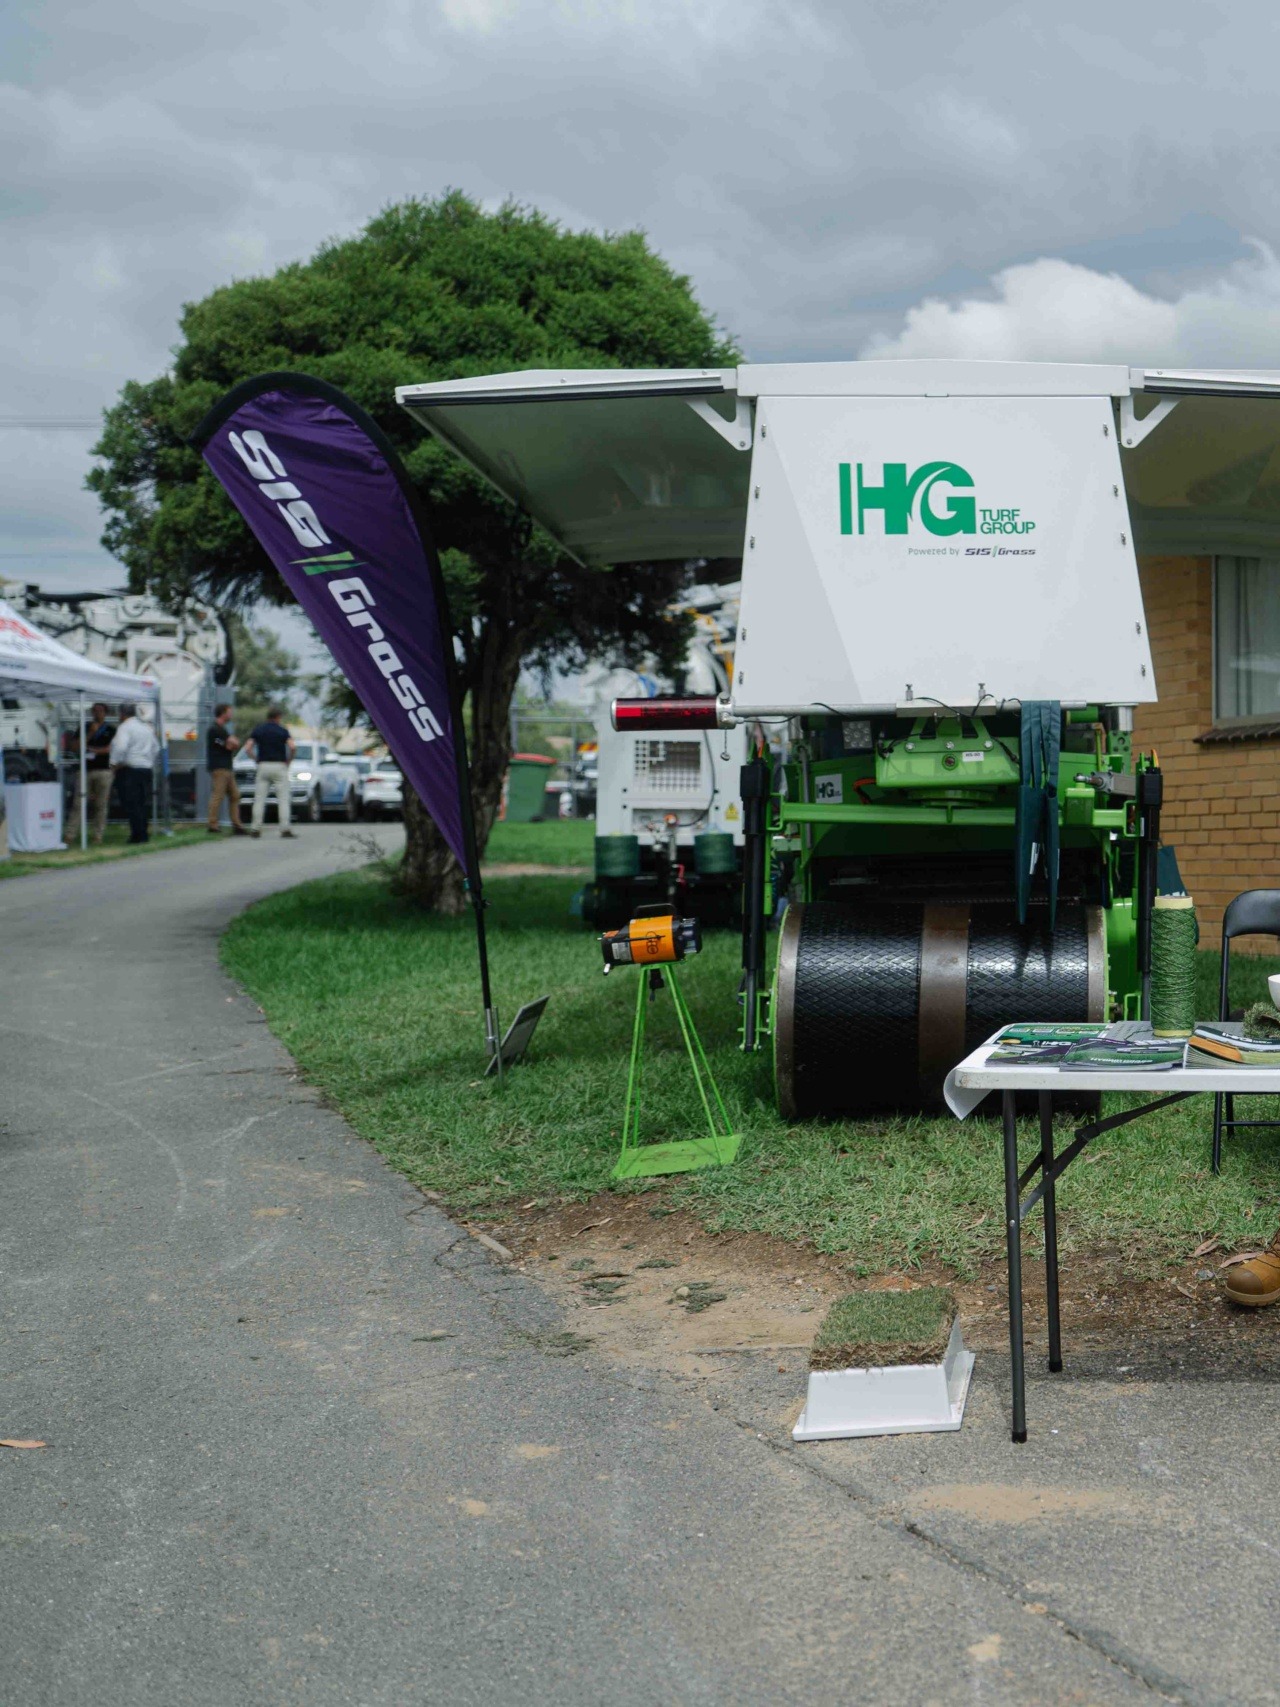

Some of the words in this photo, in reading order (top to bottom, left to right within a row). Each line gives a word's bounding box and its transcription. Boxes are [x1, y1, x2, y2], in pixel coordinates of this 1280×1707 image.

[839, 461, 976, 537] HG
[979, 509, 1020, 522] TURF
[980, 521, 1036, 534] GROUP
[908, 547, 947, 557] Powered
[950, 547, 960, 559] by
[964, 548, 992, 556] SIS
[998, 548, 1036, 556] Grass
[229, 430, 332, 547] SIS
[328, 577, 444, 742] Grass
